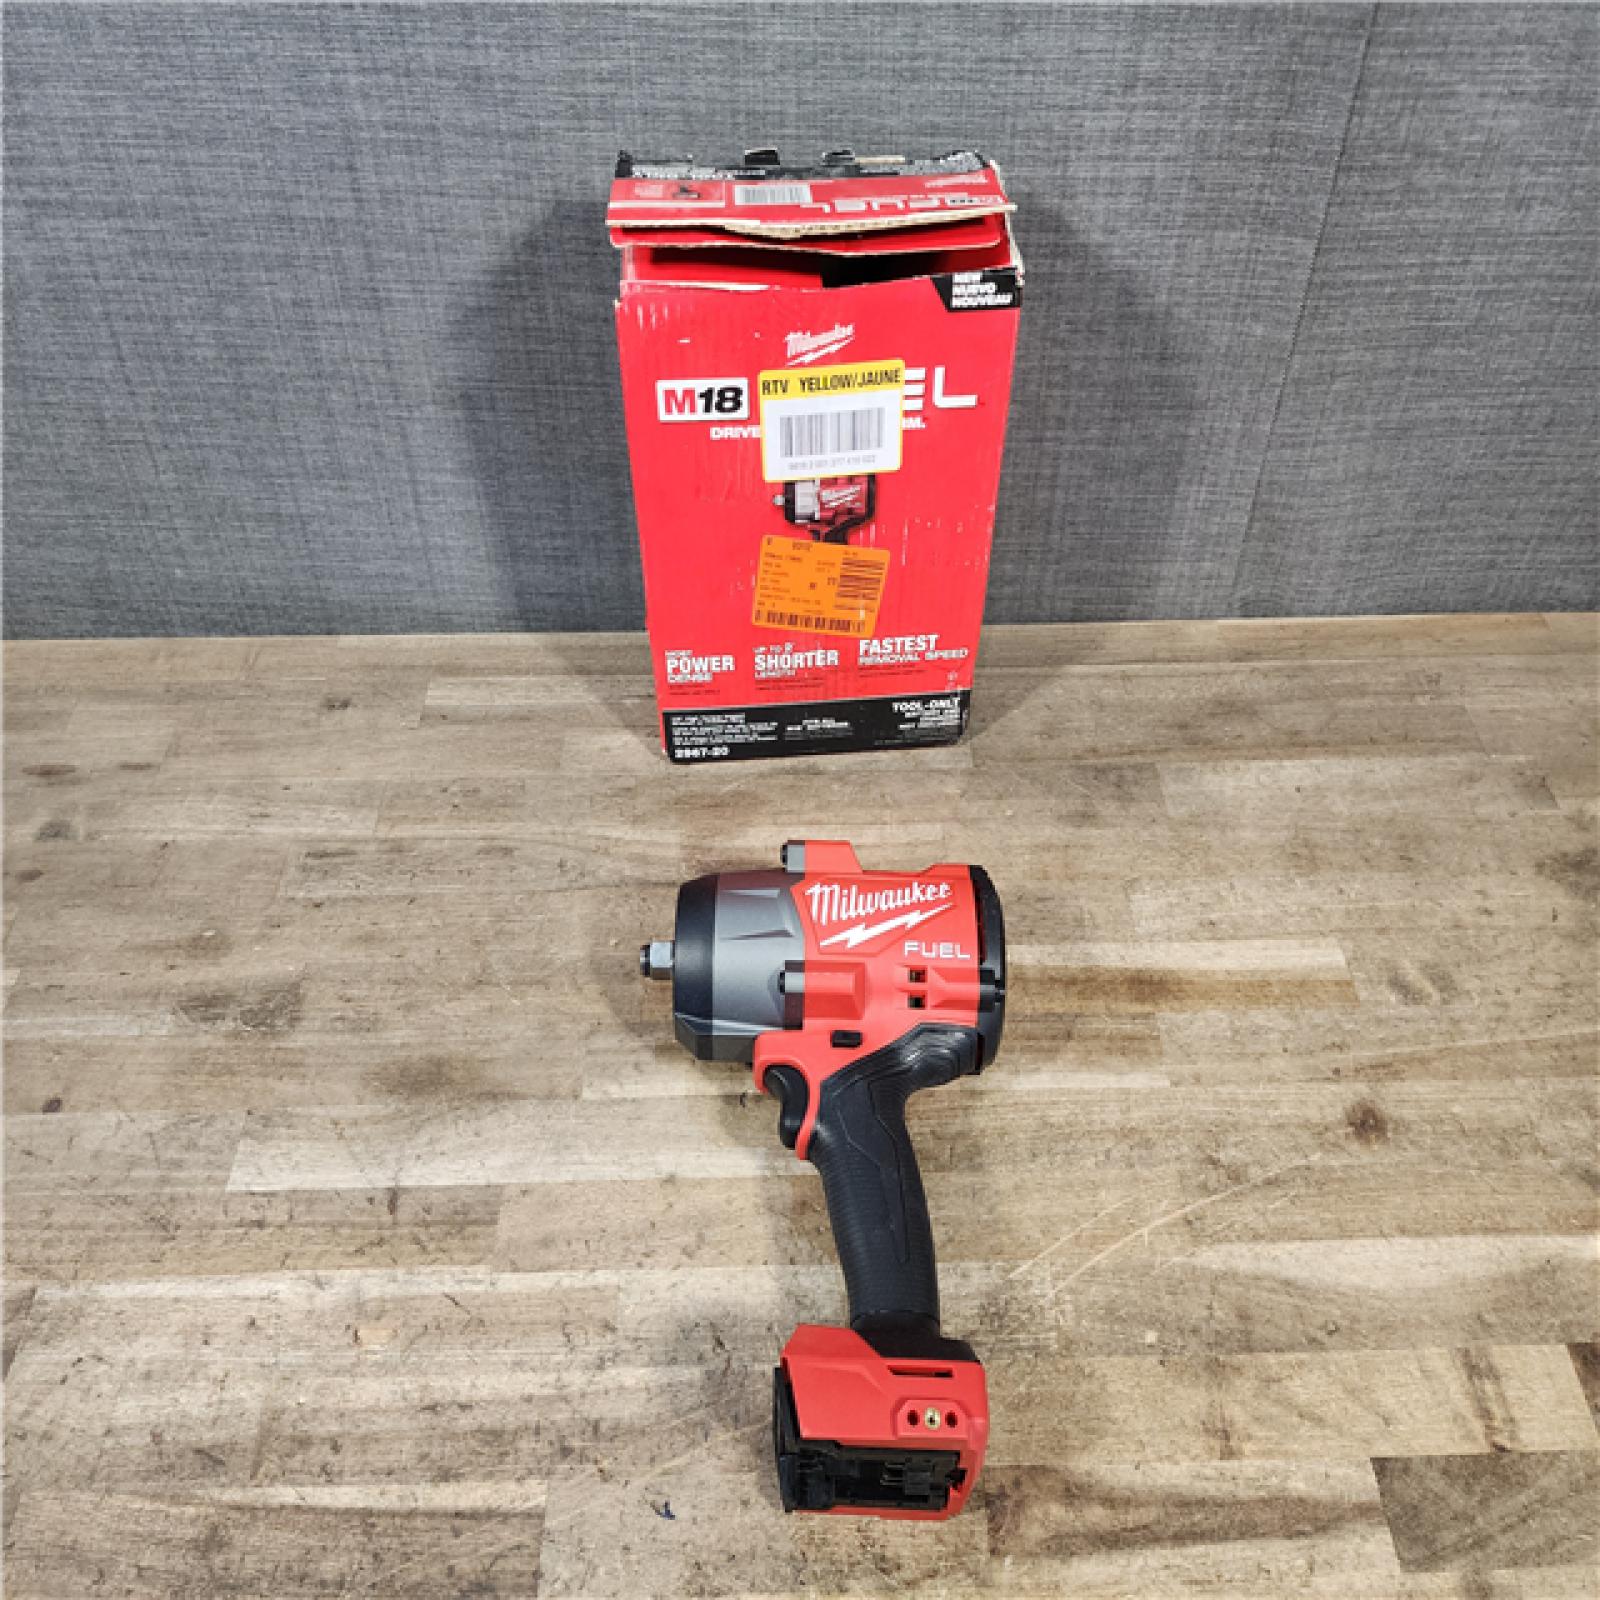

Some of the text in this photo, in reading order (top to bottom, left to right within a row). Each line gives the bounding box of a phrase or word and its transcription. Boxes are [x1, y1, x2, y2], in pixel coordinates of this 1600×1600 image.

[762, 367, 901, 395] RTV YELLOW/JAUNE
[663, 386, 743, 416] M18
[710, 425, 761, 440] DRIVE
[859, 633, 939, 656] FASTEST
[666, 655, 735, 673] POWER
[754, 650, 839, 671] SHORTER
[805, 881, 953, 927] Milwaukee
[904, 940, 971, 959] FUEL
